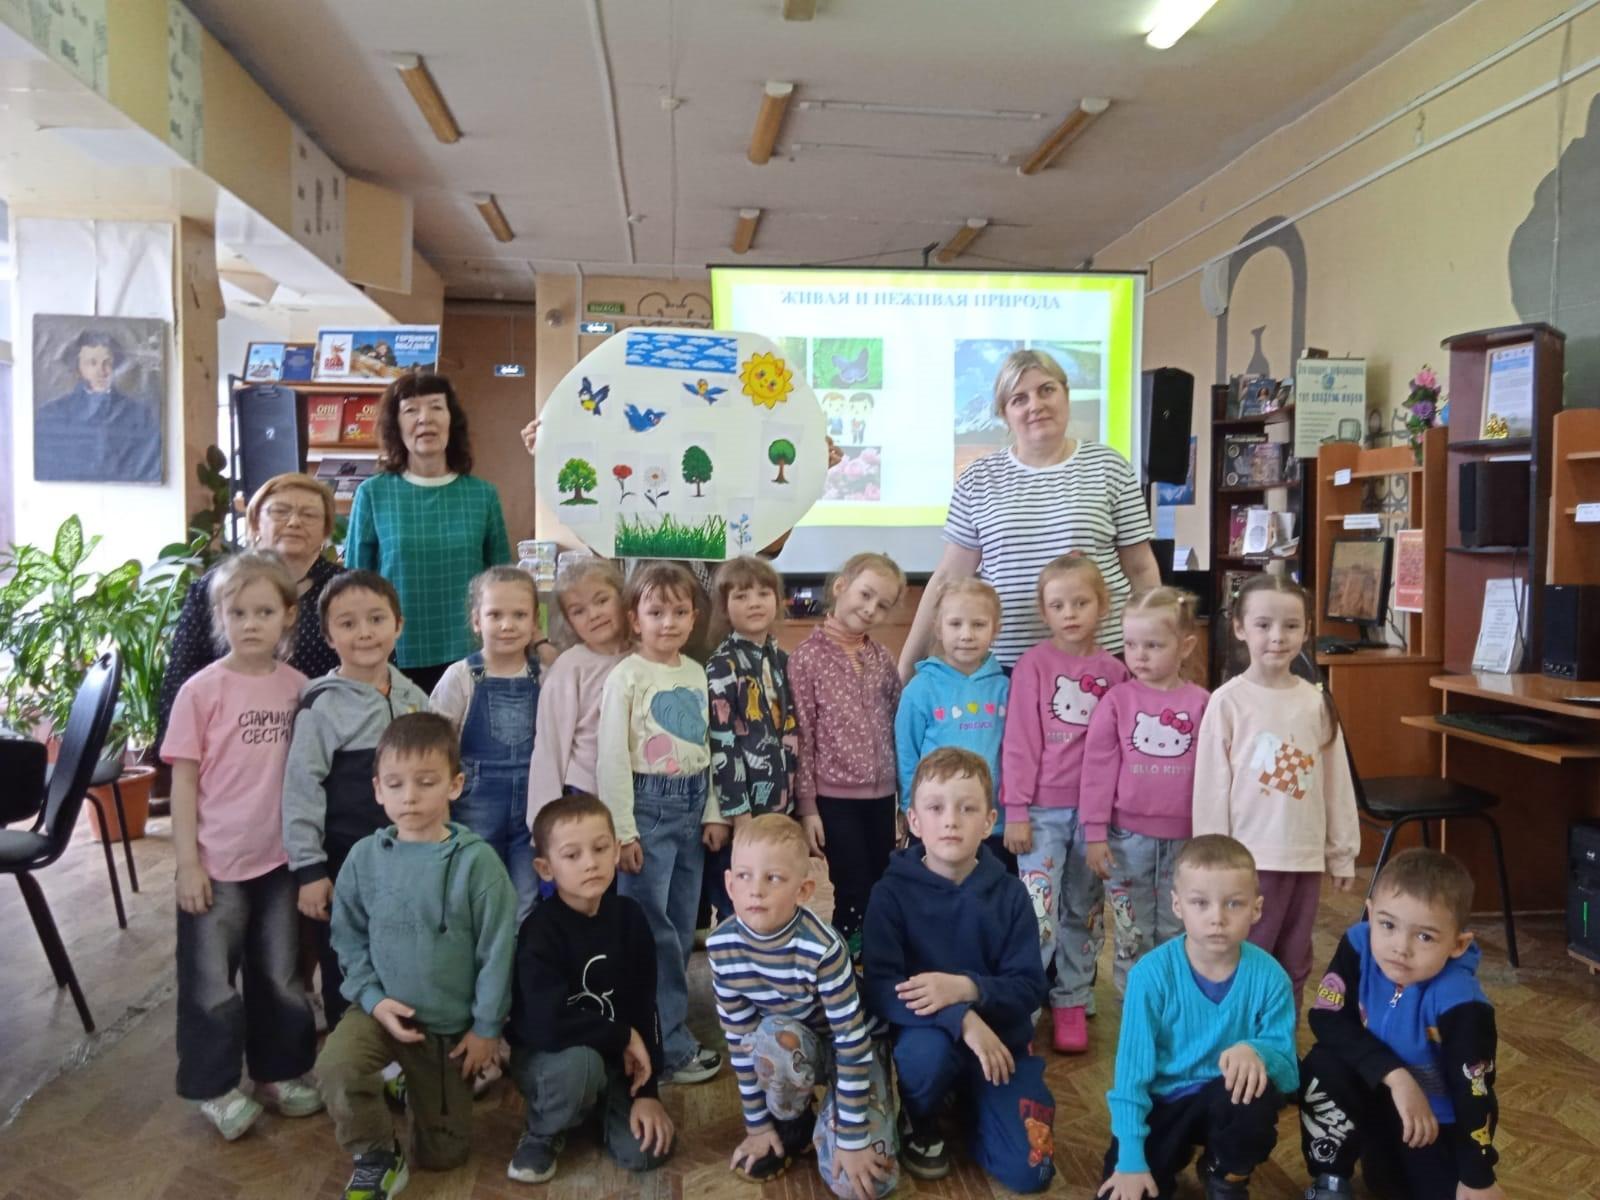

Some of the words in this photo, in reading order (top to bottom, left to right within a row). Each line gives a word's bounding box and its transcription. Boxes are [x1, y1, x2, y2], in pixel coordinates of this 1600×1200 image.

[782, 290, 850, 305] ЖИВАЯ
[855, 292, 869, 305] И
[874, 292, 969, 308] НЕЖИВАЯ
[974, 294, 1062, 310] ПРИРОДА
